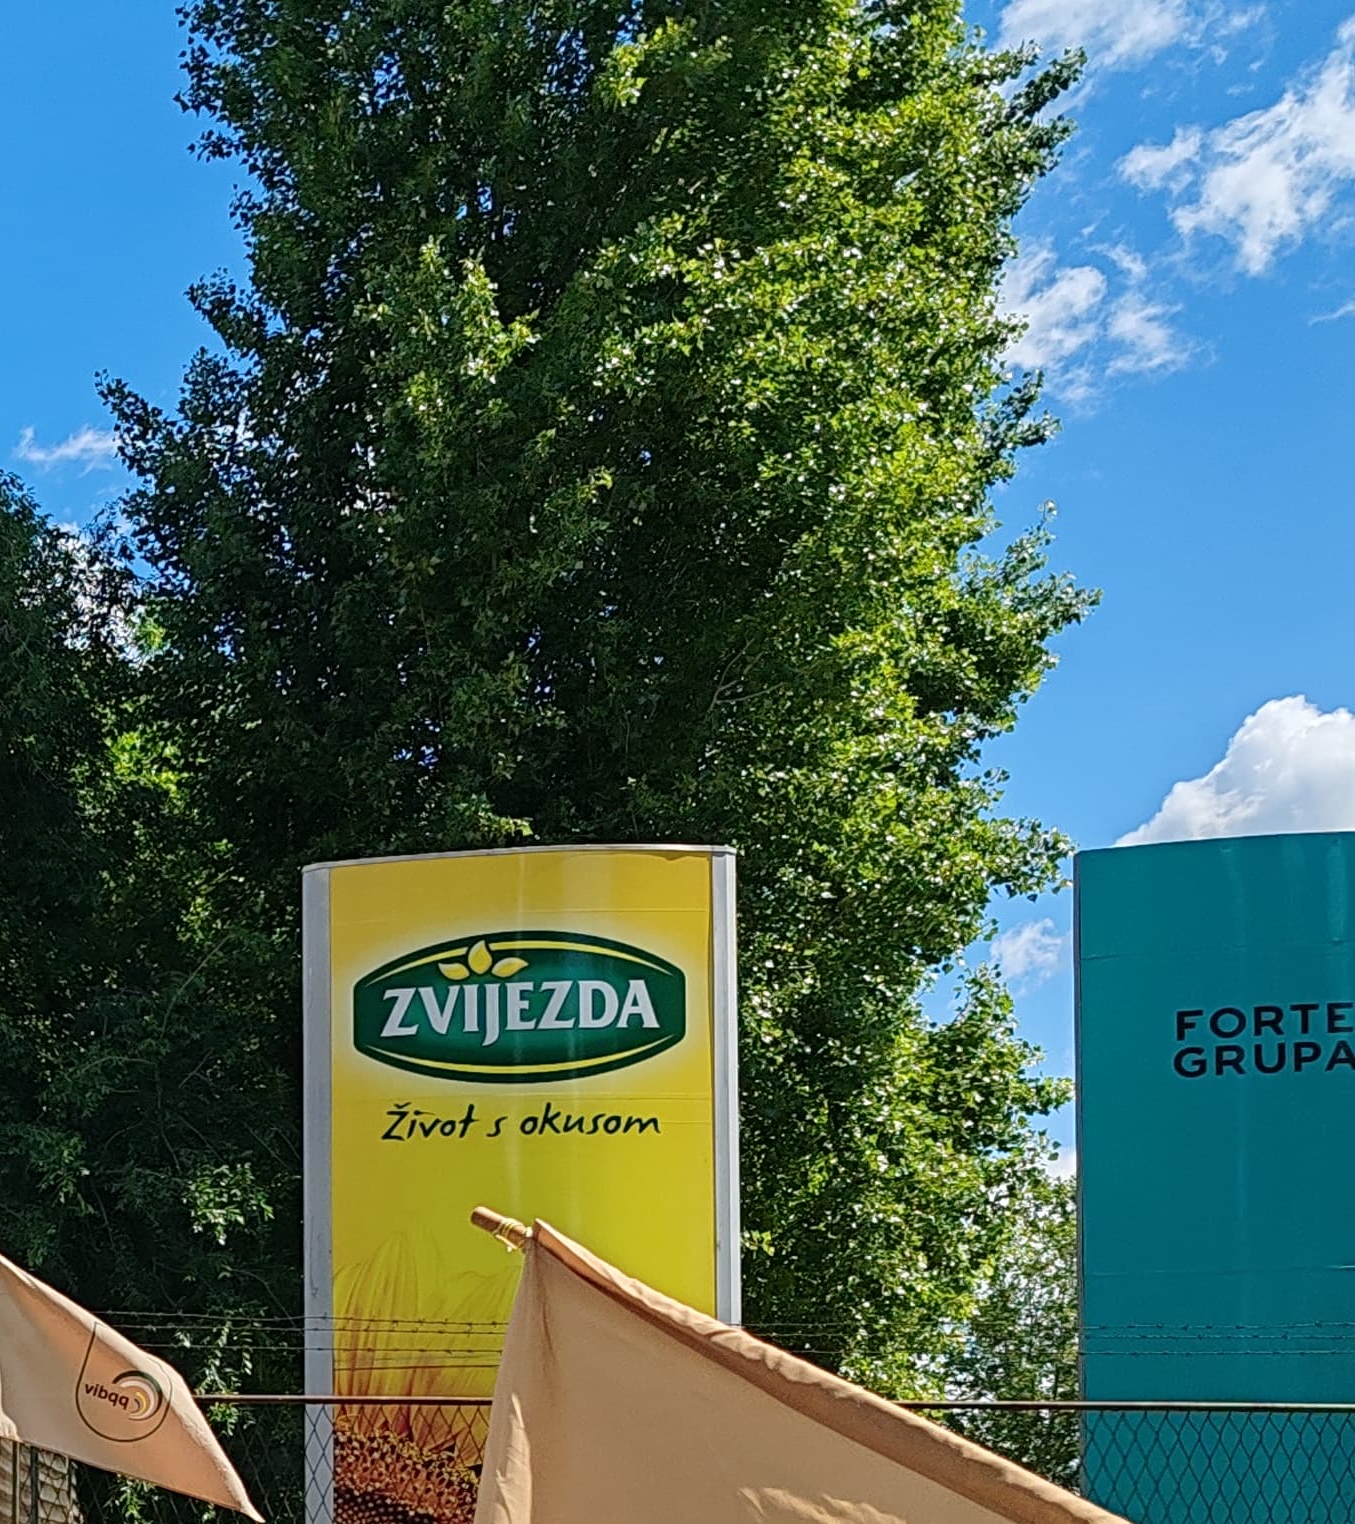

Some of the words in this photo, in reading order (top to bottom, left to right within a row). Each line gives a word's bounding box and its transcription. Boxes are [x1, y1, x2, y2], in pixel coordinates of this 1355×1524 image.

[379, 979, 661, 1047] ZVIJEZDA
[1175, 1002, 1354, 1041] FORTE
[1173, 1040, 1355, 1078] GRUPA
[381, 1102, 479, 1142] Život
[487, 1116, 508, 1138] s
[520, 1102, 662, 1136] okusom
